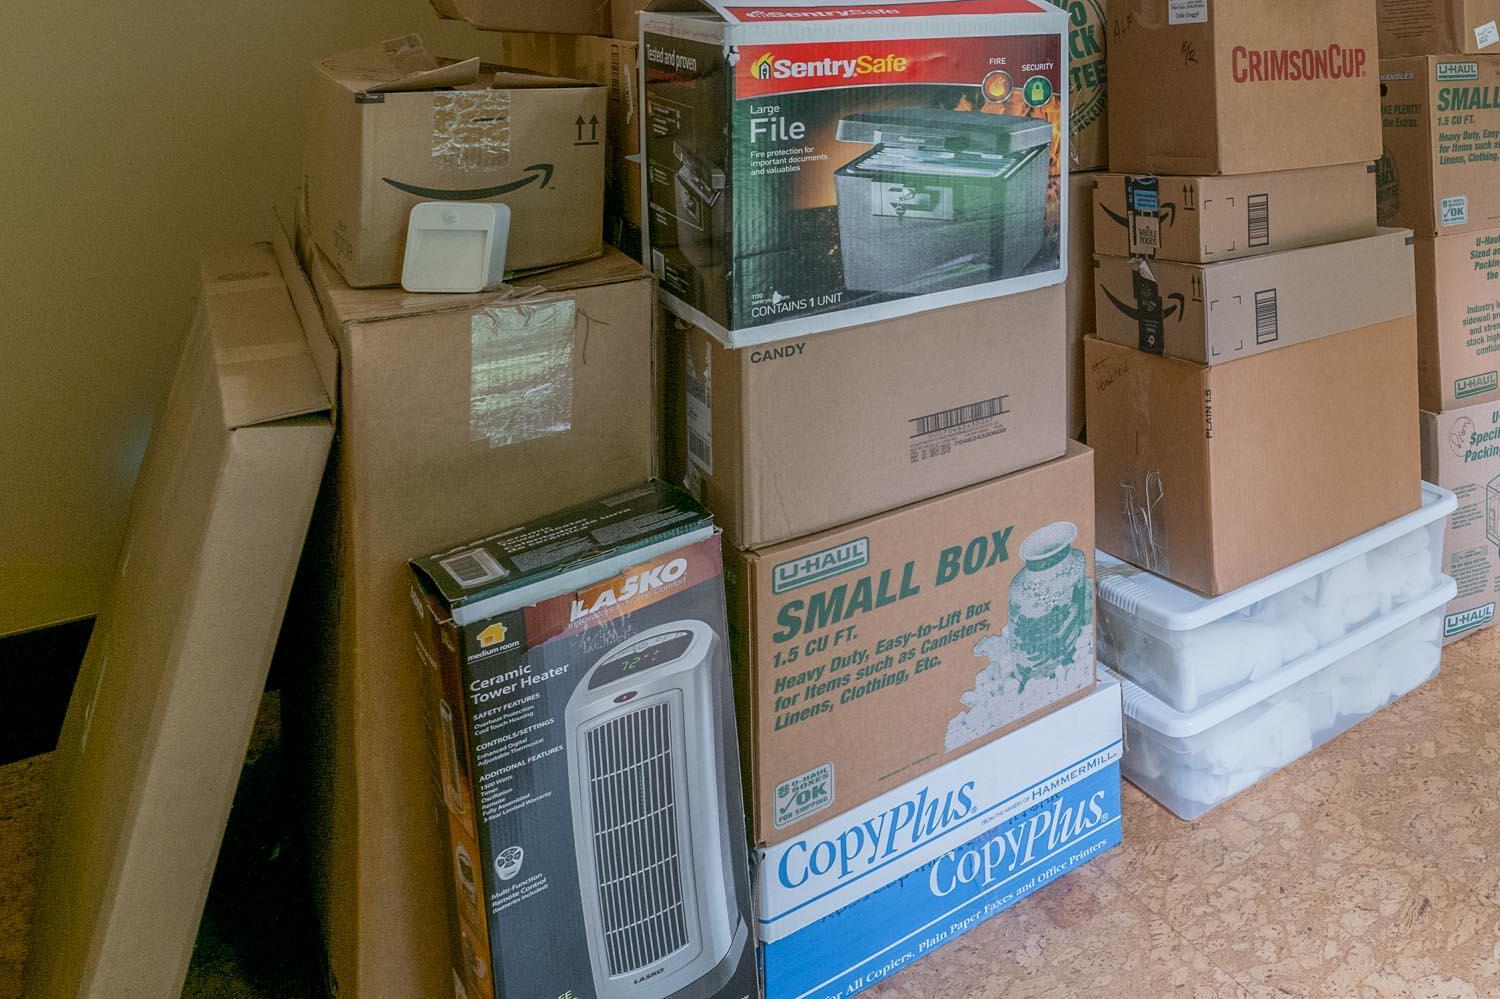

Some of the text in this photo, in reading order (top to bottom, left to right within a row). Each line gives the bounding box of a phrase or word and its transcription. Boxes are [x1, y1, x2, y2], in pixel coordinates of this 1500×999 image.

[646, 44, 696, 71] Tested and proven
[773, 54, 907, 78] SentrySafe
[989, 57, 1007, 65] FIRE
[1021, 62, 1054, 72] SECURITY
[1439, 65, 1476, 74] U-HAUL
[750, 104, 781, 116] Large
[750, 116, 806, 143] File
[1437, 116, 1462, 126] 1.5 CU
[1439, 132, 1461, 142] Heavy
[1463, 130, 1480, 141] Duty,
[767, 147, 803, 158] protection
[1439, 144, 1450, 154] for
[1475, 140, 1492, 151] such
[751, 153, 828, 168] important documents
[1440, 154, 1466, 165] Linens,
[1468, 152, 1500, 162] Clothing,
[751, 165, 800, 176] and valuables
[1140, 237, 1157, 246] FOODS
[1470, 248, 1490, 259] Sized
[1487, 270, 1498, 280] the
[751, 299, 807, 317] CONTAINS
[809, 298, 814, 307] 1
[817, 293, 842, 306] UNIT
[1467, 303, 1494, 314] Industry
[1462, 313, 1490, 326] sidewall
[1470, 326, 1481, 335] and
[1467, 336, 1485, 347] stack
[751, 343, 806, 363] CANDY
[1457, 375, 1495, 391] U-HAUL
[779, 544, 864, 582] U-HAUL
[570, 558, 688, 622] LASKO
[772, 561, 921, 644] SMALL
[935, 525, 1016, 587] BOX
[1447, 607, 1492, 628] U-HAUL
[467, 641, 520, 661] medium room
[772, 625, 858, 669] 1.5 CU FT.
[774, 601, 992, 694] Heavy Duty, Easy-to-Lift Box
[774, 619, 991, 713] for Items such as Canisters,
[470, 665, 532, 692] Ceramic
[471, 664, 570, 705] Tower Heater
[774, 655, 942, 732] Linens, Clothing, Etc.
[473, 692, 540, 721] SAFETY FEATURES
[503, 705, 534, 719] Protection
[476, 718, 554, 751] CONTROLS/SETTINGS
[477, 746, 507, 760] Enhanced
[511, 738, 544, 754] Thermostat
[479, 744, 564, 782] ADDITIONAL FEATURES
[791, 767, 829, 787] U-HAUL
[792, 773, 829, 793] BOXES
[796, 782, 827, 806] OK
[503, 802, 525, 815] Limited
[778, 797, 828, 822] FOR SHIPPING
[778, 781, 975, 889] CopyPlus
[928, 791, 1105, 897] CopyPlus
[491, 872, 543, 900] Multi-Function
[492, 878, 547, 908] Remote Control
[846, 838, 1107, 996] All Plain Paper Faxes and Office Printers
[634, 968, 665, 985] LASKO
